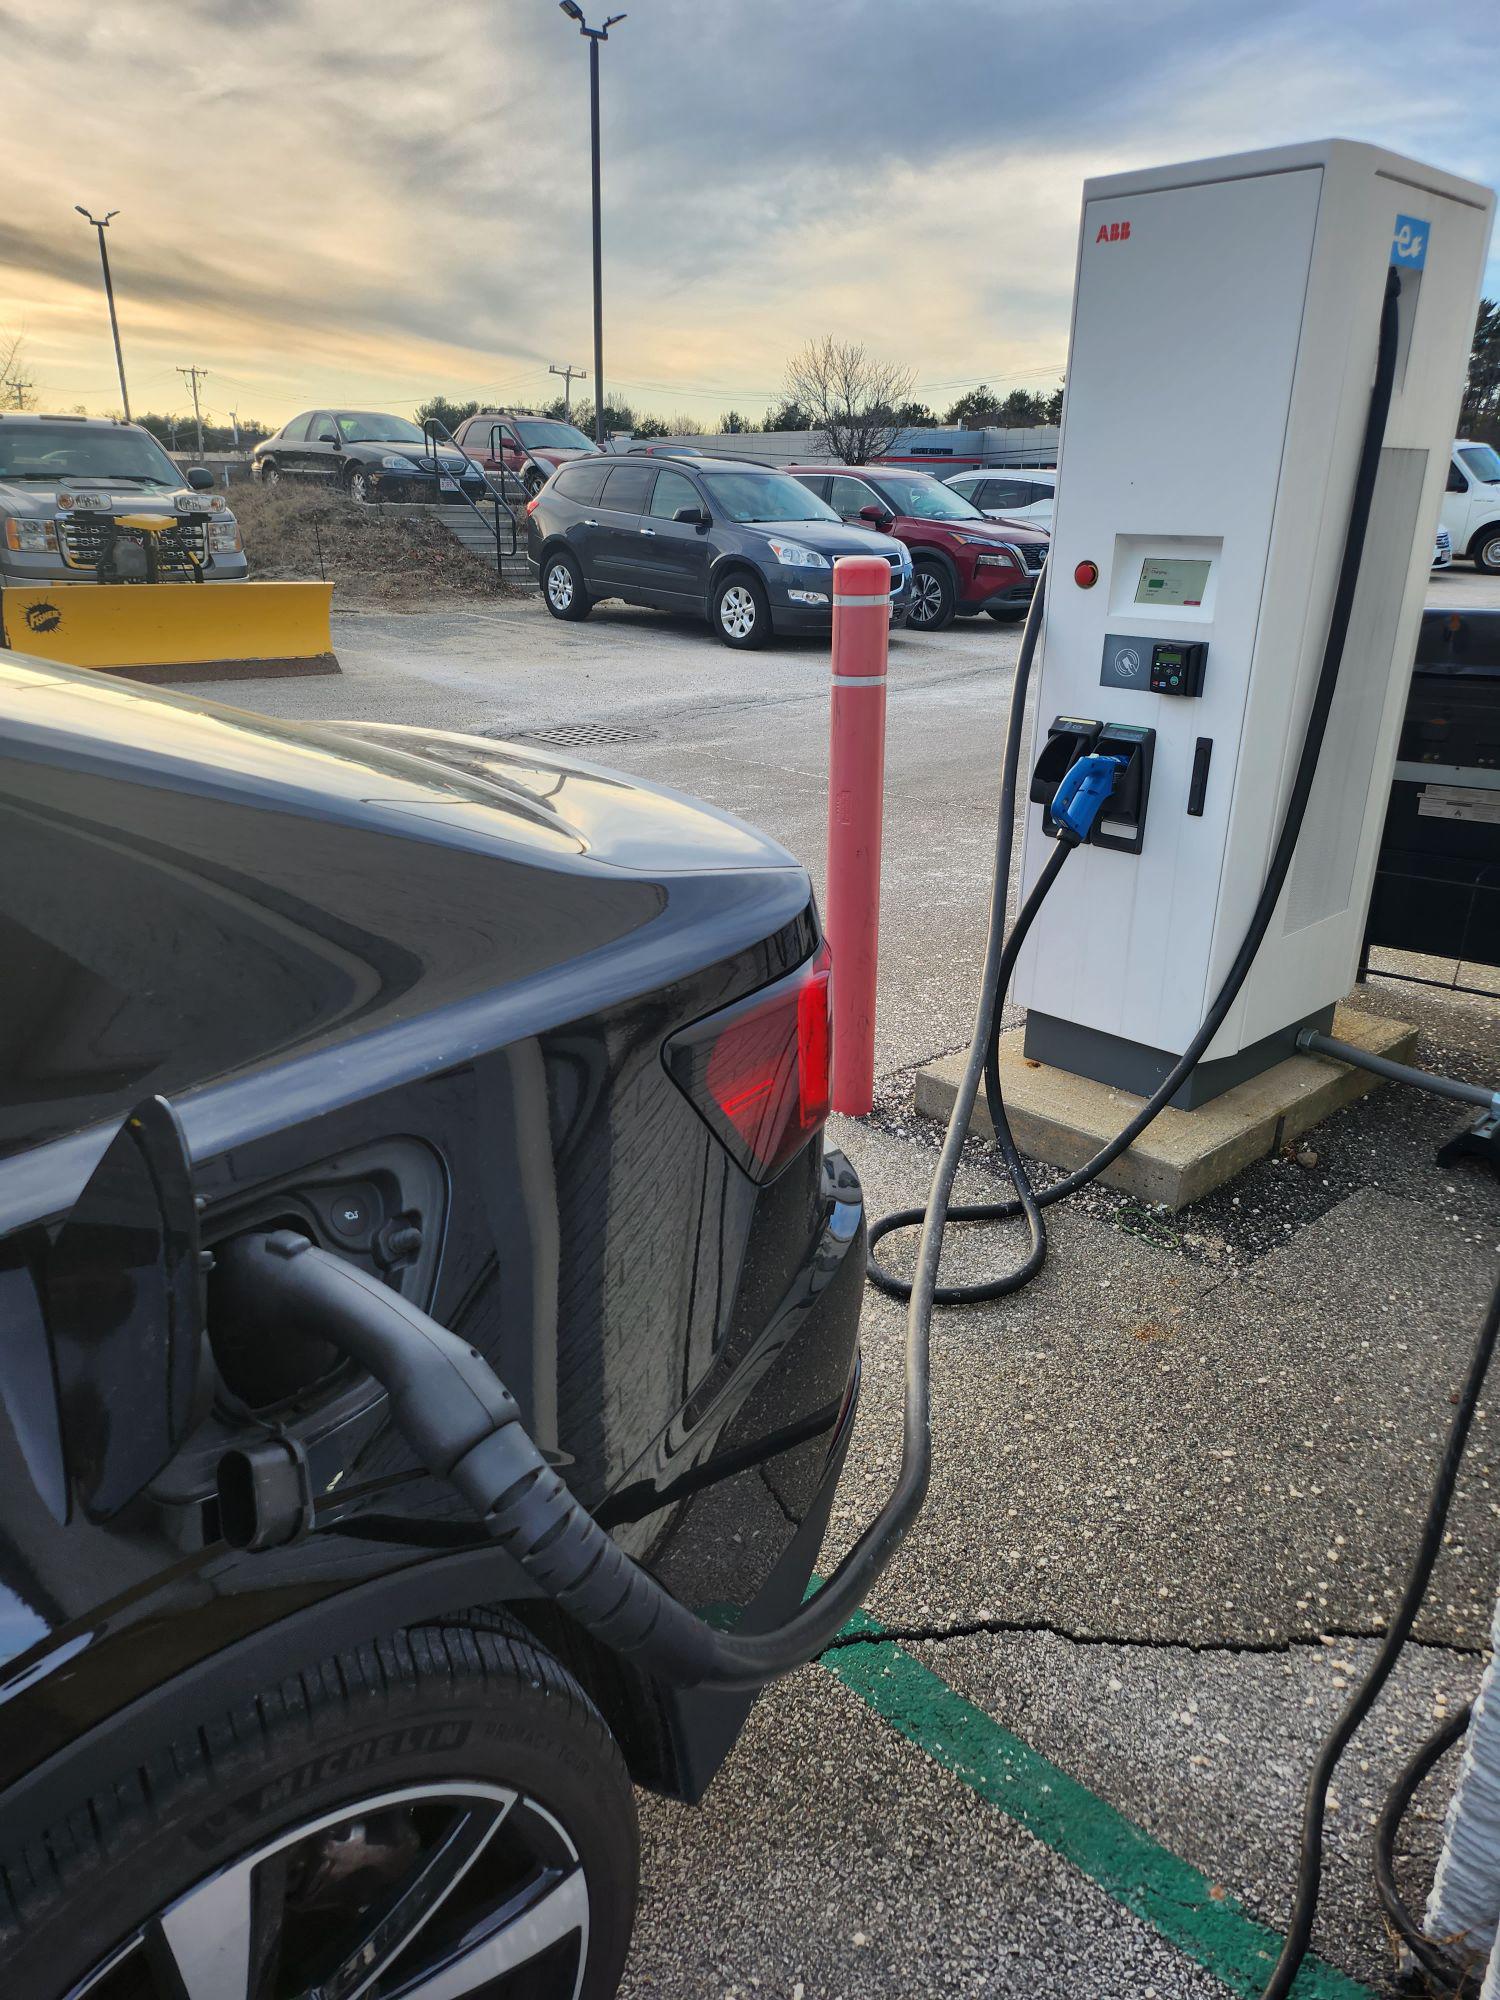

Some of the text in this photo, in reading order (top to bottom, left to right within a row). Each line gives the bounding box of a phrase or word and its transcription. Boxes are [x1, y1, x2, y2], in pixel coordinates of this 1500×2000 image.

[1095, 221, 1131, 243] ABB
[30, 610, 62, 628] FISHER
[259, 1721, 466, 1810] MICHELIN
